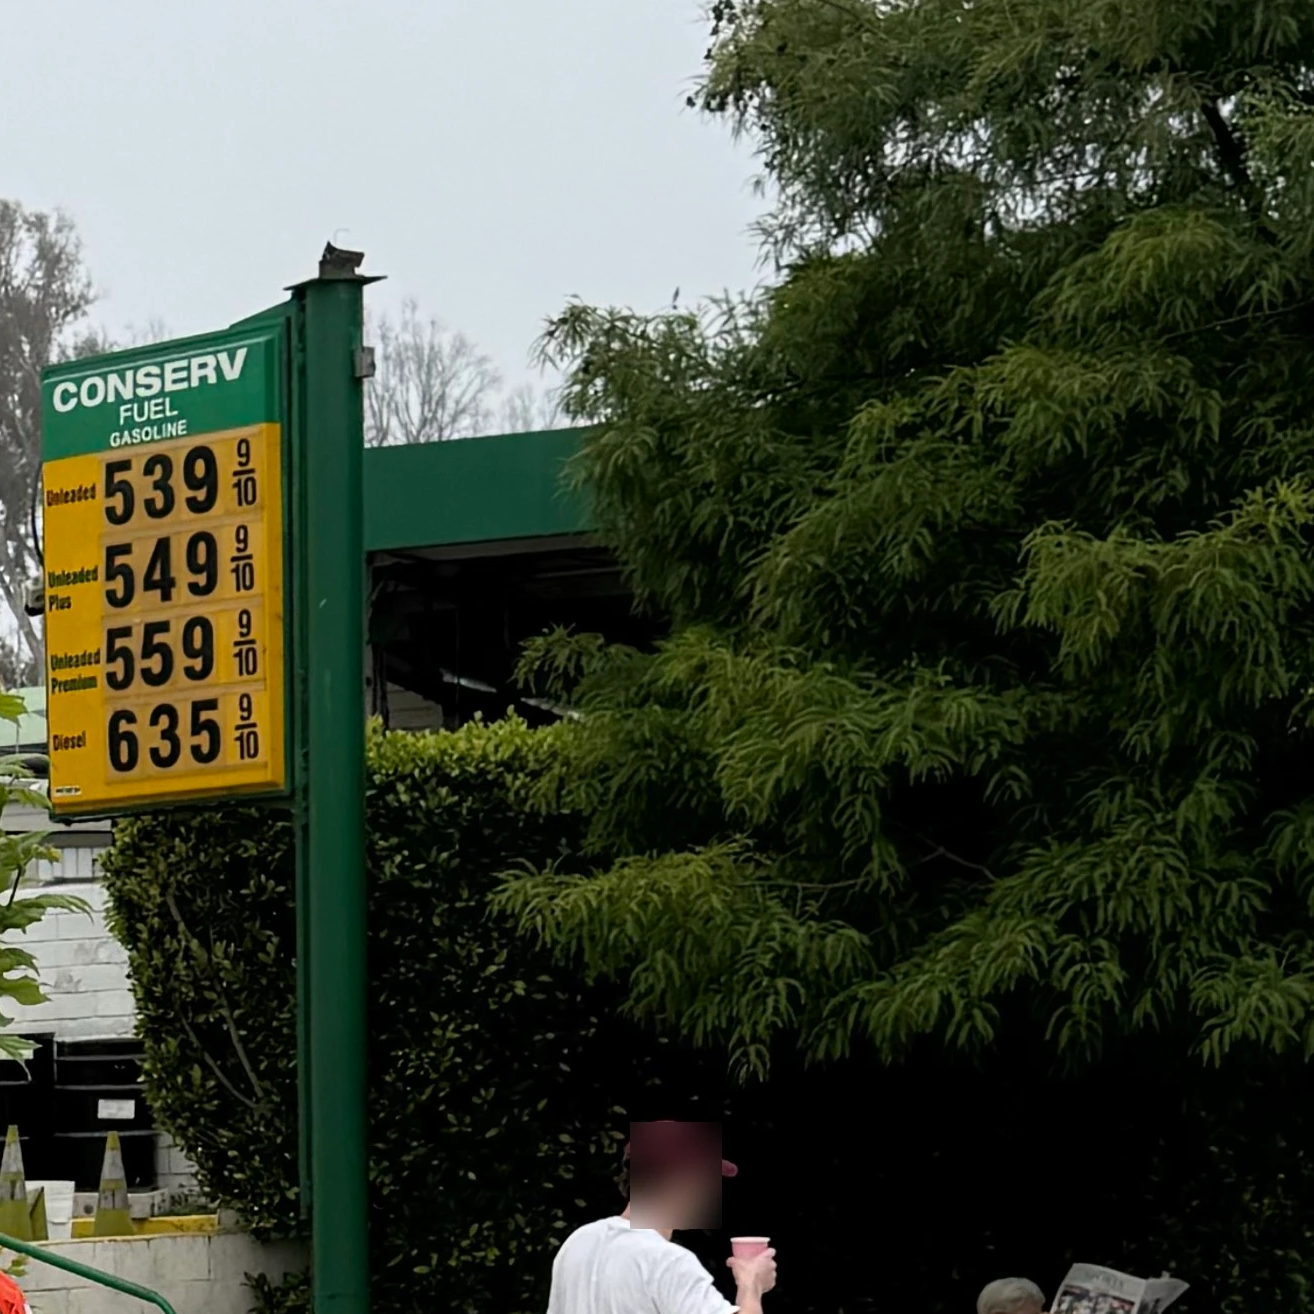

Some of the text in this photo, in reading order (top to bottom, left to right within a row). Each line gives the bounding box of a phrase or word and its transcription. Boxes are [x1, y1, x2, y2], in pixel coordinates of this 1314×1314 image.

[52, 348, 248, 413] CONSERV
[119, 398, 179, 425] FUEL
[109, 420, 188, 448] GASOLINE
[236, 438, 251, 467] 9
[46, 445, 219, 526] Unleaded 539
[232, 476, 257, 507] 10
[234, 524, 249, 553] 9
[47, 531, 219, 609] Unleaded 549
[231, 562, 255, 593] 10
[48, 595, 72, 612] Plus
[238, 609, 252, 638] 9
[50, 615, 215, 691] Unleaded 559
[233, 647, 258, 677] 10
[50, 673, 98, 694] Premium
[238, 693, 253, 721] 9
[52, 698, 222, 772] Diesel 635
[234, 730, 260, 760] 10
